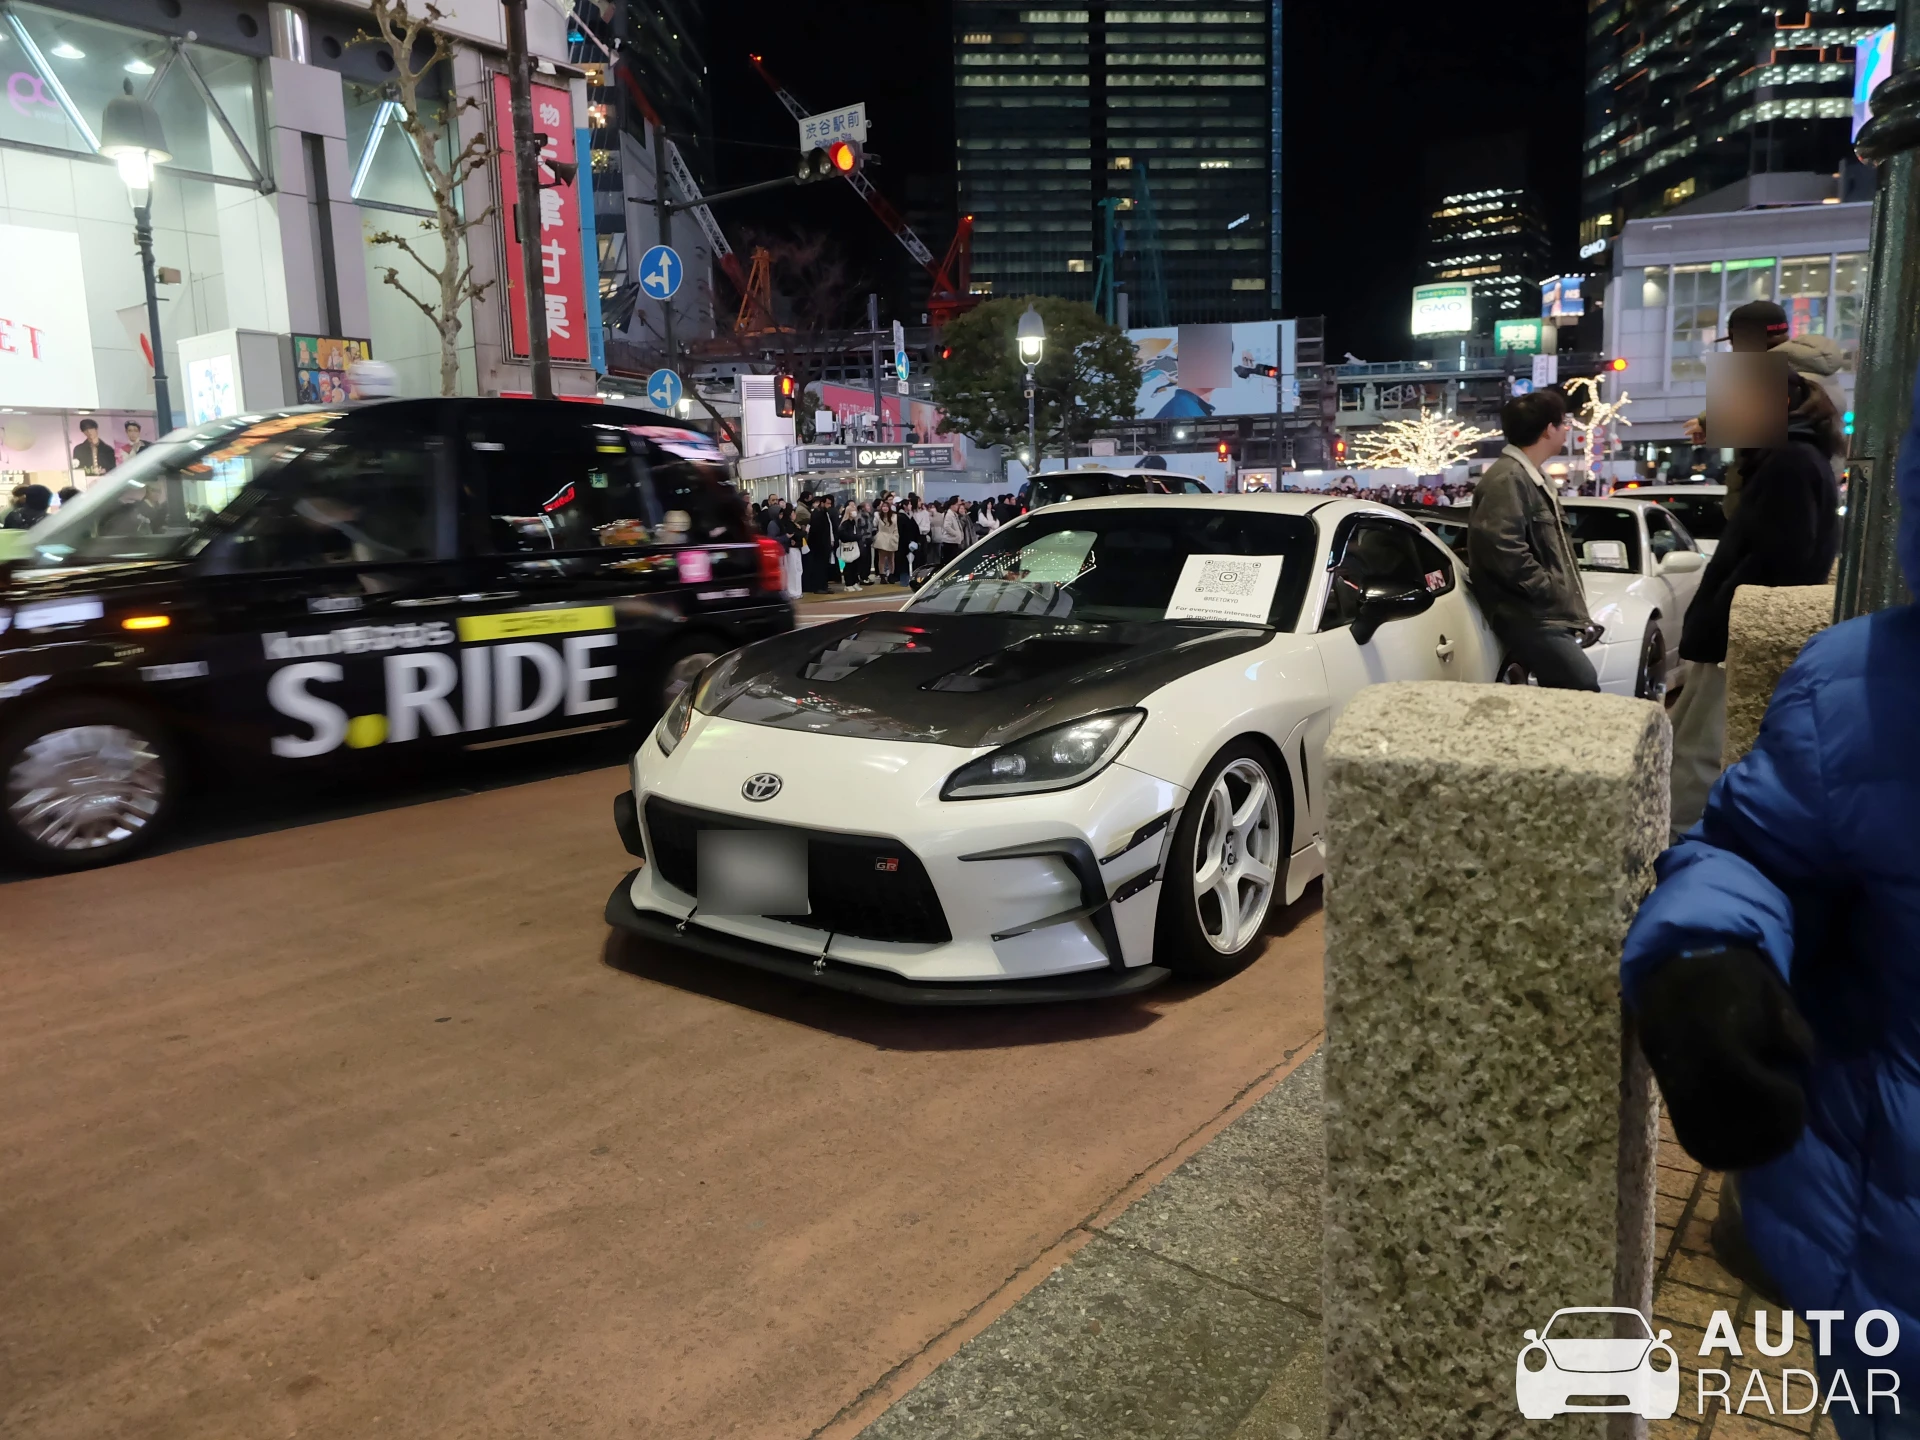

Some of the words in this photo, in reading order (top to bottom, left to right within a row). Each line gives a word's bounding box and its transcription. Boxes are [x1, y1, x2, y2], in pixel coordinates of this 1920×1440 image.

[806, 111, 860, 140] 渋谷駅前
[1580, 239, 1606, 258] GMO
[1420, 302, 1462, 314] GMO
[1189, 607, 1223, 615] everyone
[1224, 610, 1262, 619] interested
[266, 633, 618, 759] S.RIDE
[876, 862, 897, 870] GR
